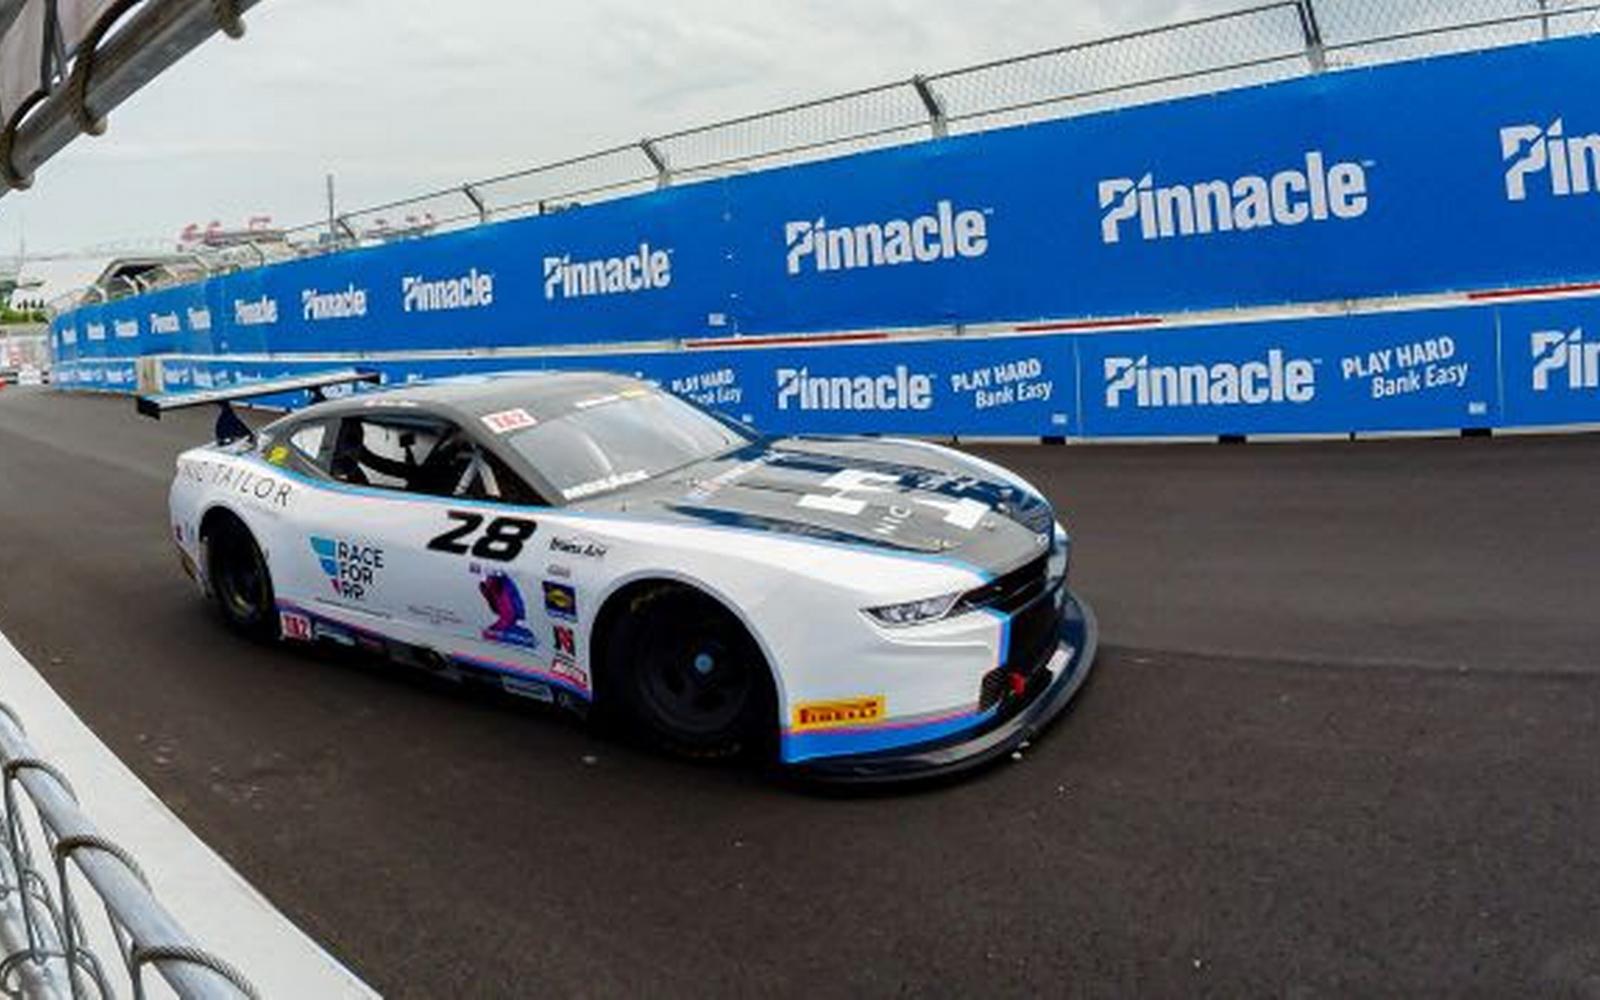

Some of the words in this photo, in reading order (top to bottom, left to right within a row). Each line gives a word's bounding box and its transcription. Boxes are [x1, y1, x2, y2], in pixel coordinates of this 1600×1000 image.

[1098, 151, 1367, 243] Pinnacle
[786, 200, 988, 274] Pinnacle
[403, 268, 492, 311] Pinnacle
[544, 243, 671, 299] Pinnacle
[302, 284, 367, 320] Pinnacle
[952, 368, 992, 392] PLAY
[994, 358, 1042, 384] HARD
[1104, 349, 1315, 407] Pinnacle
[1342, 350, 1392, 379] PLAY
[1396, 336, 1455, 368] HARD
[777, 365, 932, 410] Pinnacle
[976, 386, 1014, 409] Bank
[1017, 380, 1053, 401] Easy
[1371, 370, 1420, 398] Bank
[1425, 363, 1468, 388] Easy
[338, 541, 384, 568] RACE
[427, 510, 537, 562] 28
[340, 561, 373, 584] FOR
